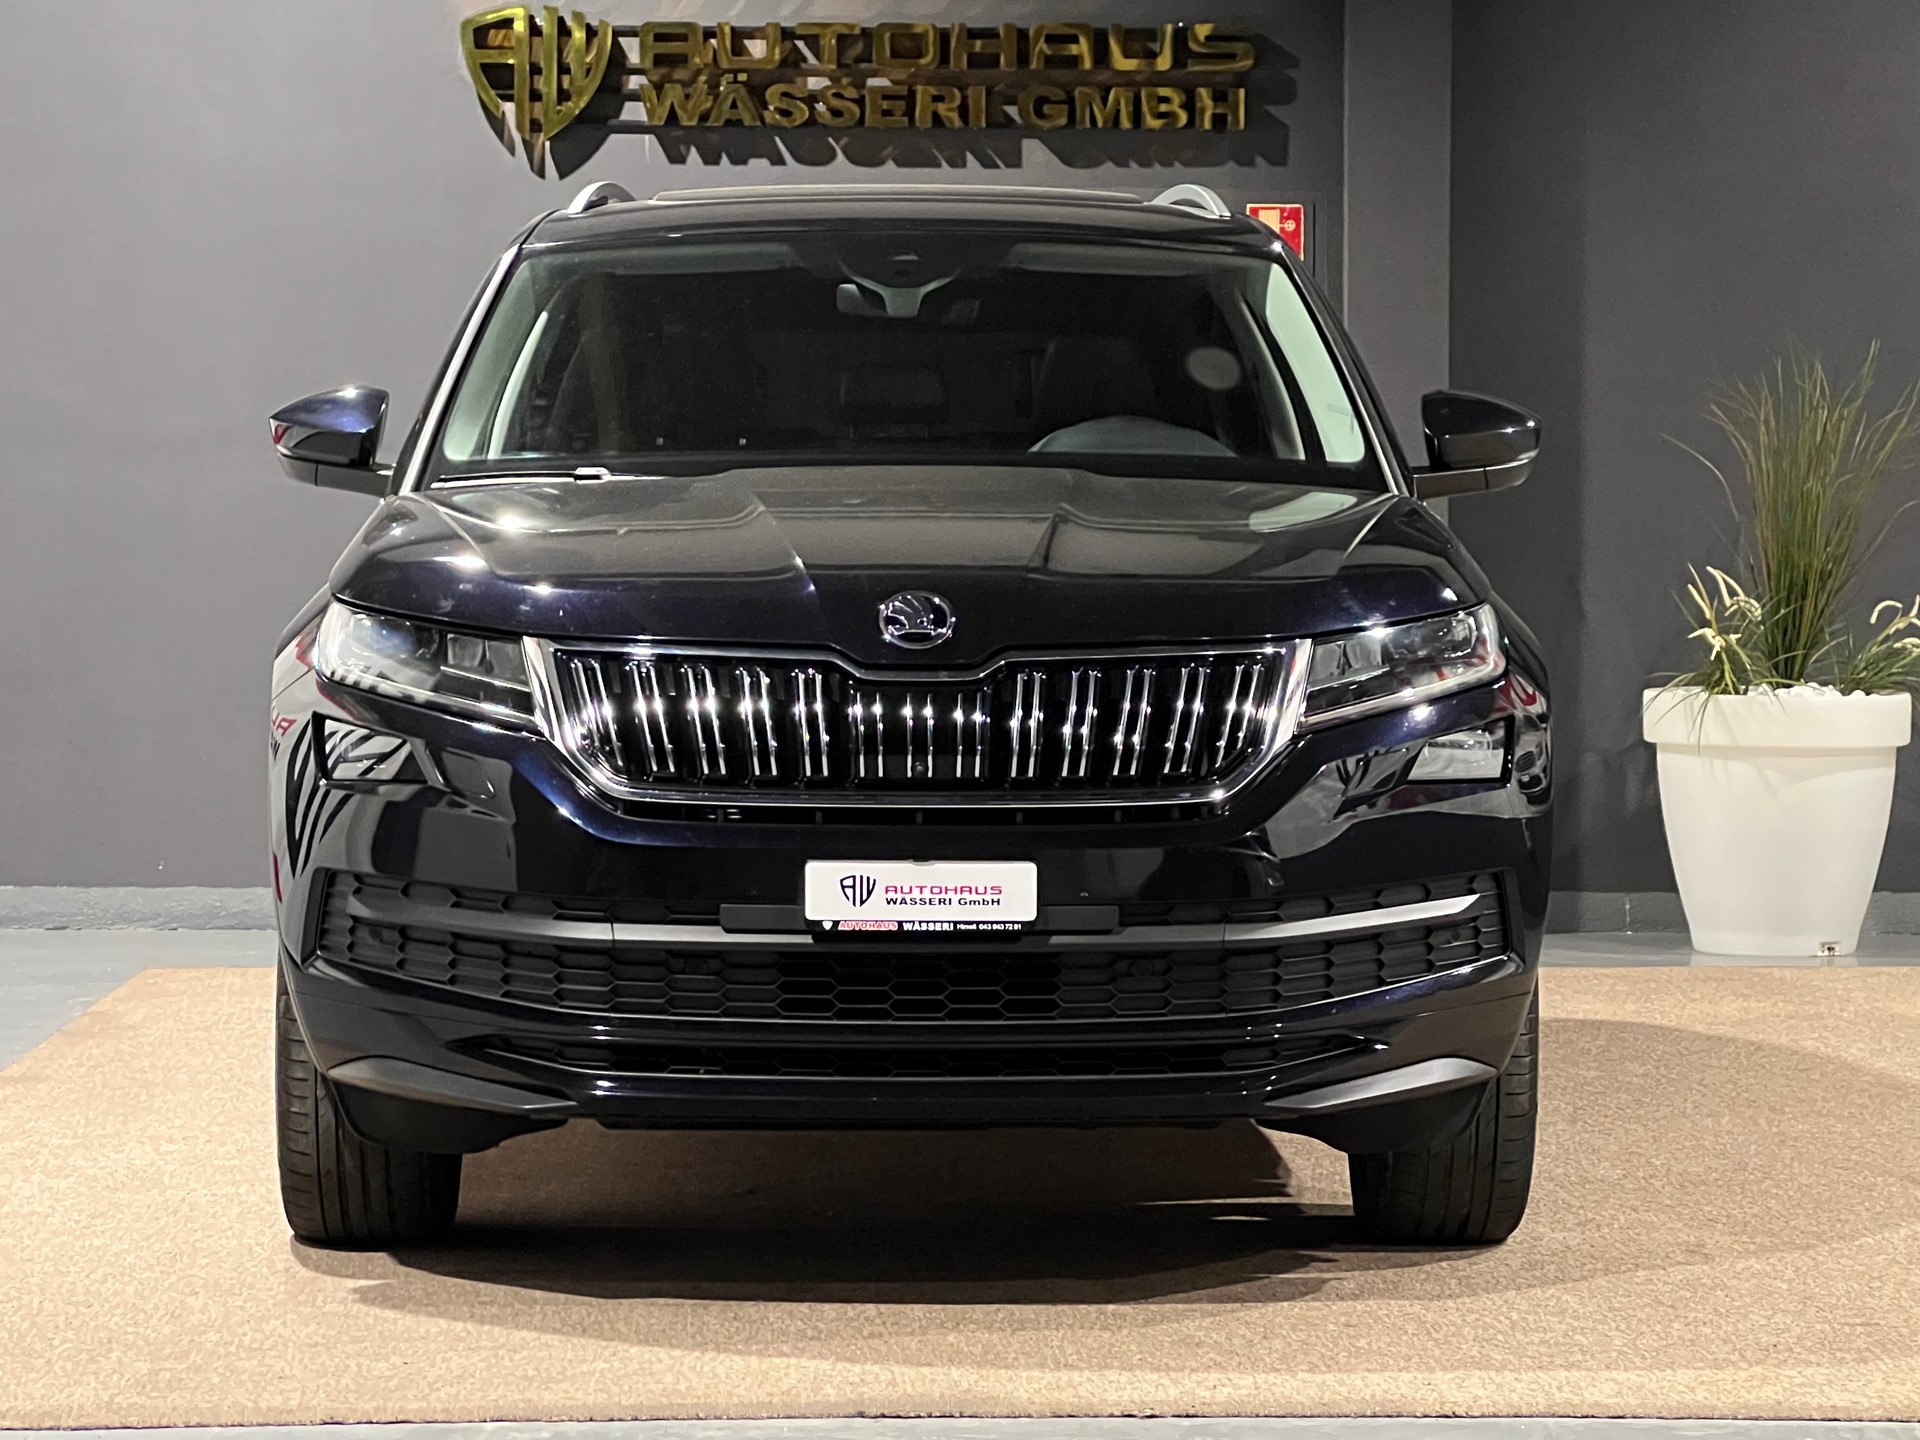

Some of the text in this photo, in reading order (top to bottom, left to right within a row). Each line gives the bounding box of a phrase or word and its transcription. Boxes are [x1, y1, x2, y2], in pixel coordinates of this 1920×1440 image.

[639, 21, 1255, 72] AUTOHAUS
[639, 72, 1246, 131] WÄSSERI GMBH
[885, 885, 1003, 895] AUTOHAUS
[885, 896, 1001, 906] WÄSSERI GmbH
[838, 921, 899, 931] AUTOHAUS
